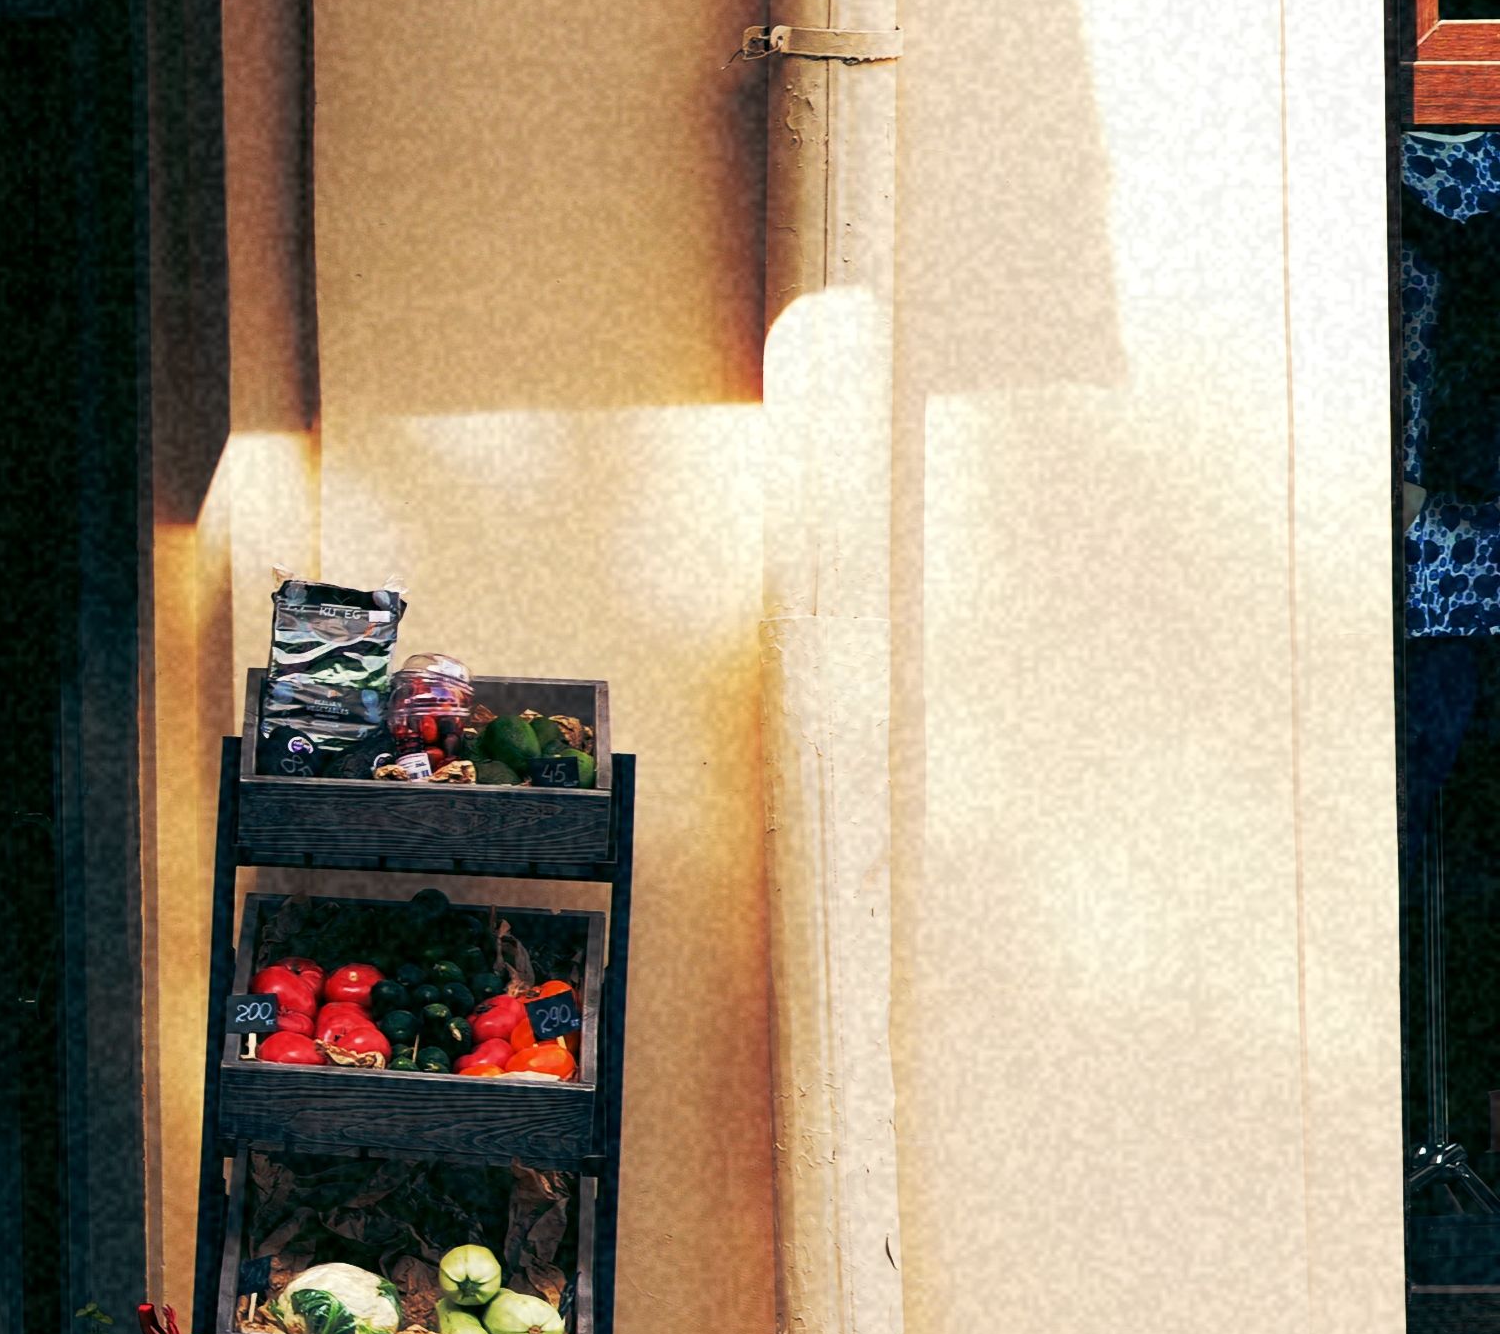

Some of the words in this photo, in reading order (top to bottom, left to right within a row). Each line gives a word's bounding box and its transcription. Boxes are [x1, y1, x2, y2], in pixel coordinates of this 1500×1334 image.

[541, 763, 567, 783] 45
[235, 1001, 273, 1024] 200
[535, 1003, 572, 1034] 290
